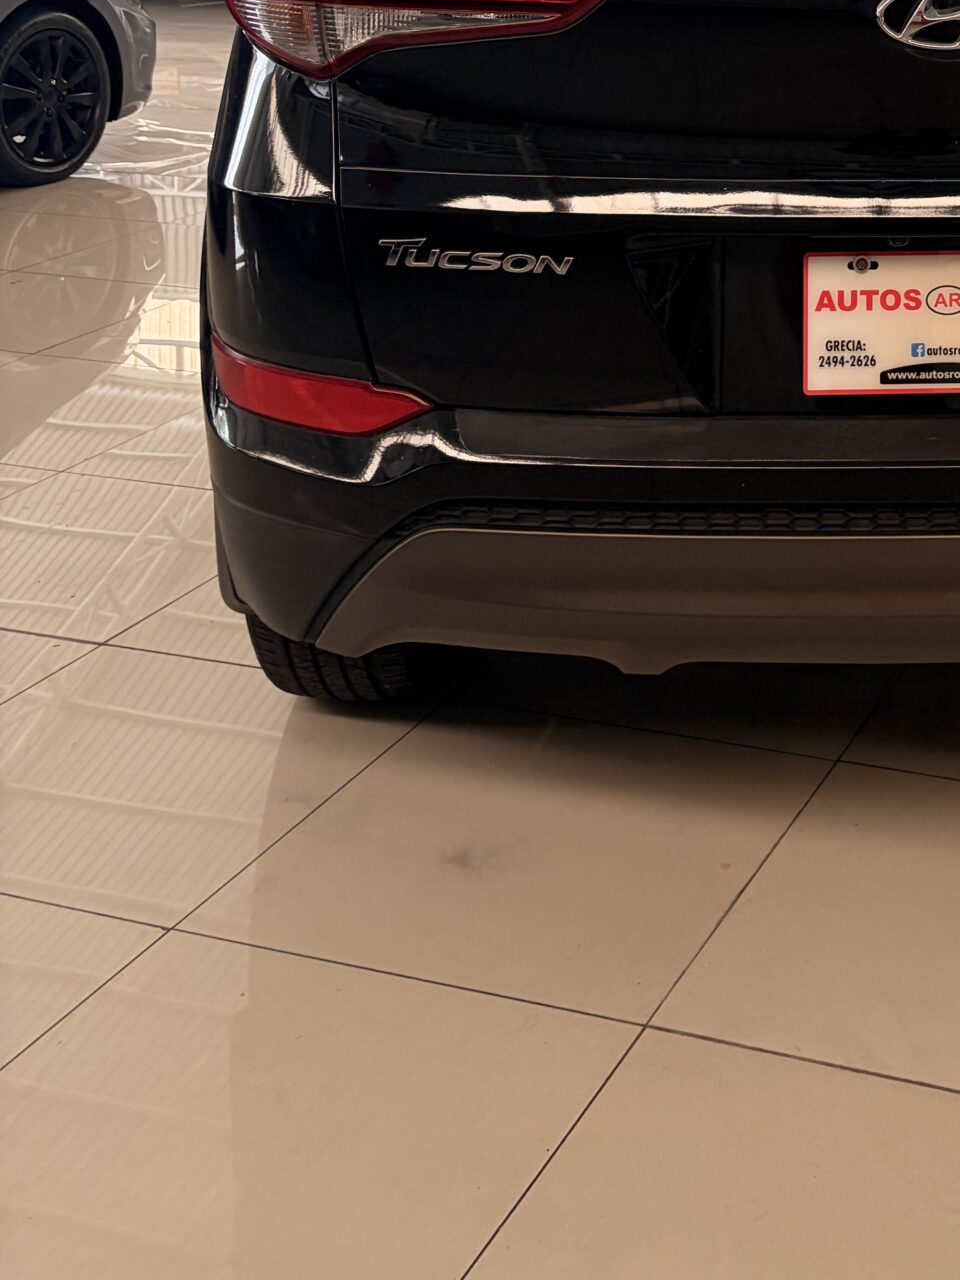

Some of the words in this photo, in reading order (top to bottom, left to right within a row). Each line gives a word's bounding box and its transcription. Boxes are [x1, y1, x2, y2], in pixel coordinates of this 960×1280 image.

[378, 237, 574, 275] TUCSON
[815, 289, 922, 312] AUTOS
[825, 340, 866, 352] GRECIA:
[818, 355, 877, 368] 2494-2626
